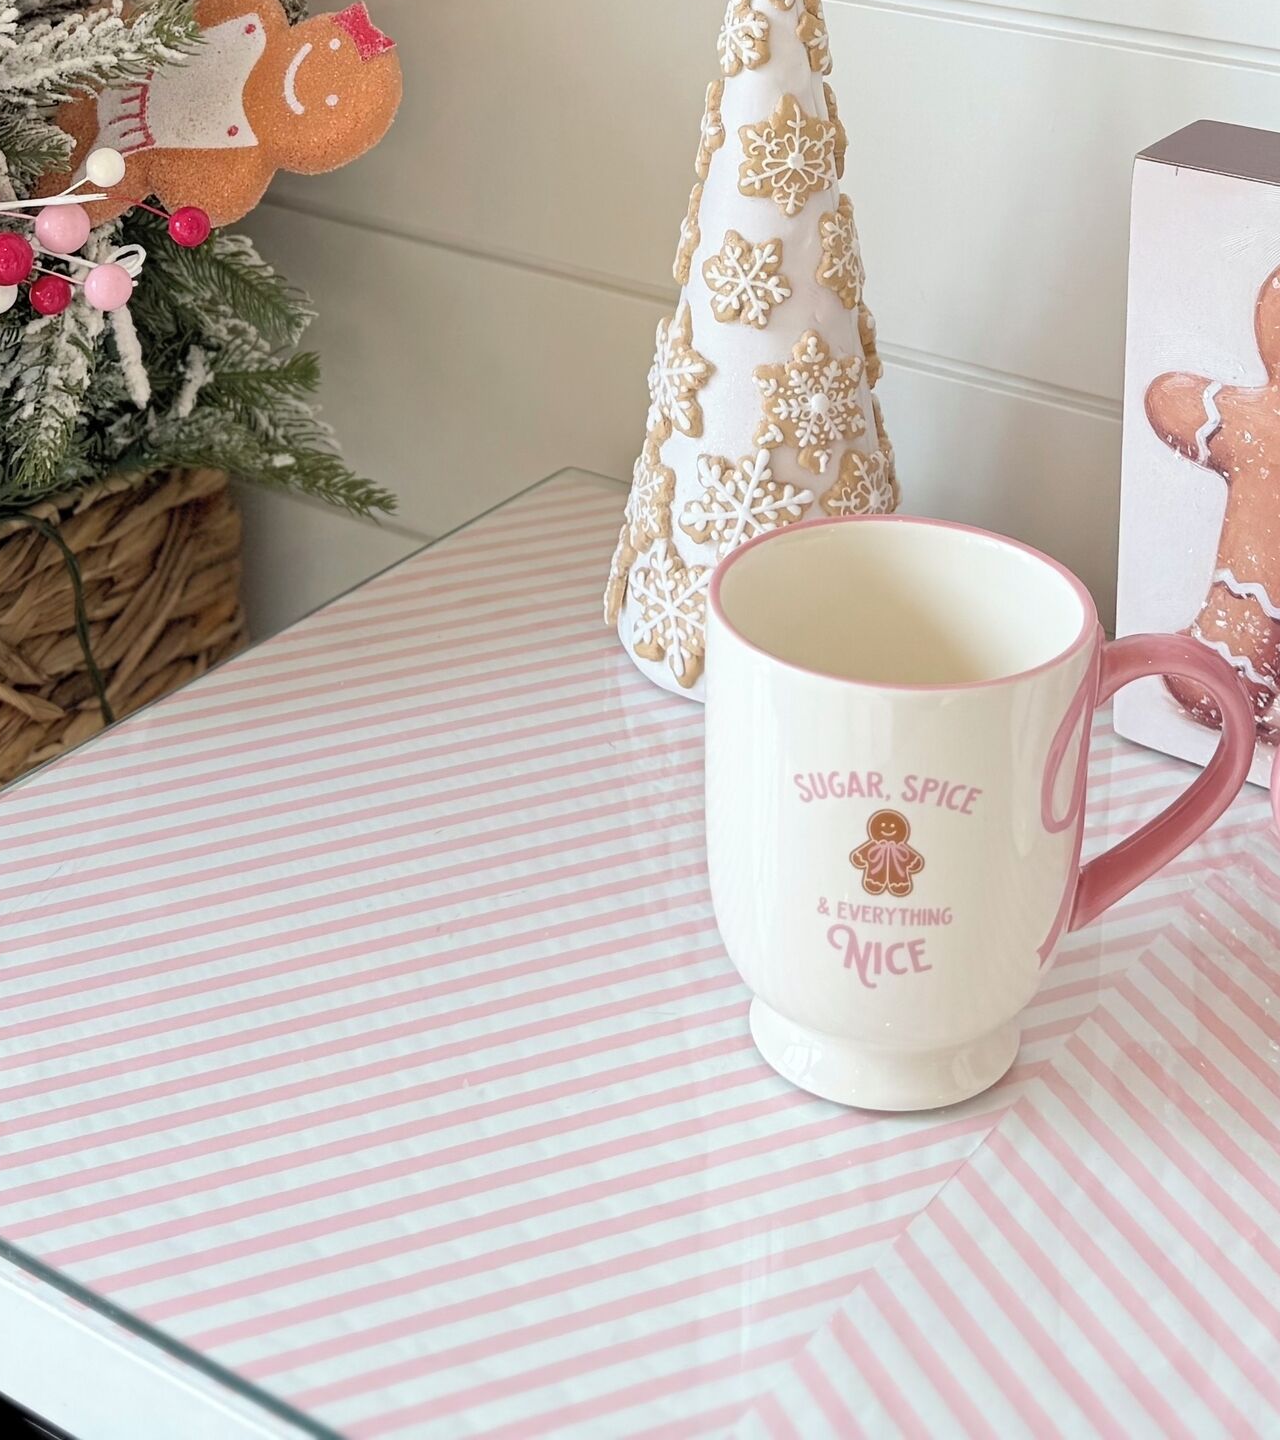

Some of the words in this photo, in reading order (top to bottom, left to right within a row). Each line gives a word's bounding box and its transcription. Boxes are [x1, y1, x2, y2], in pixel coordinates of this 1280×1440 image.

[793, 770, 891, 803] SUGAR,
[901, 775, 983, 814] SPICE
[817, 896, 831, 916] &
[836, 901, 953, 927] EVERYTHING
[826, 923, 933, 989] NICE
